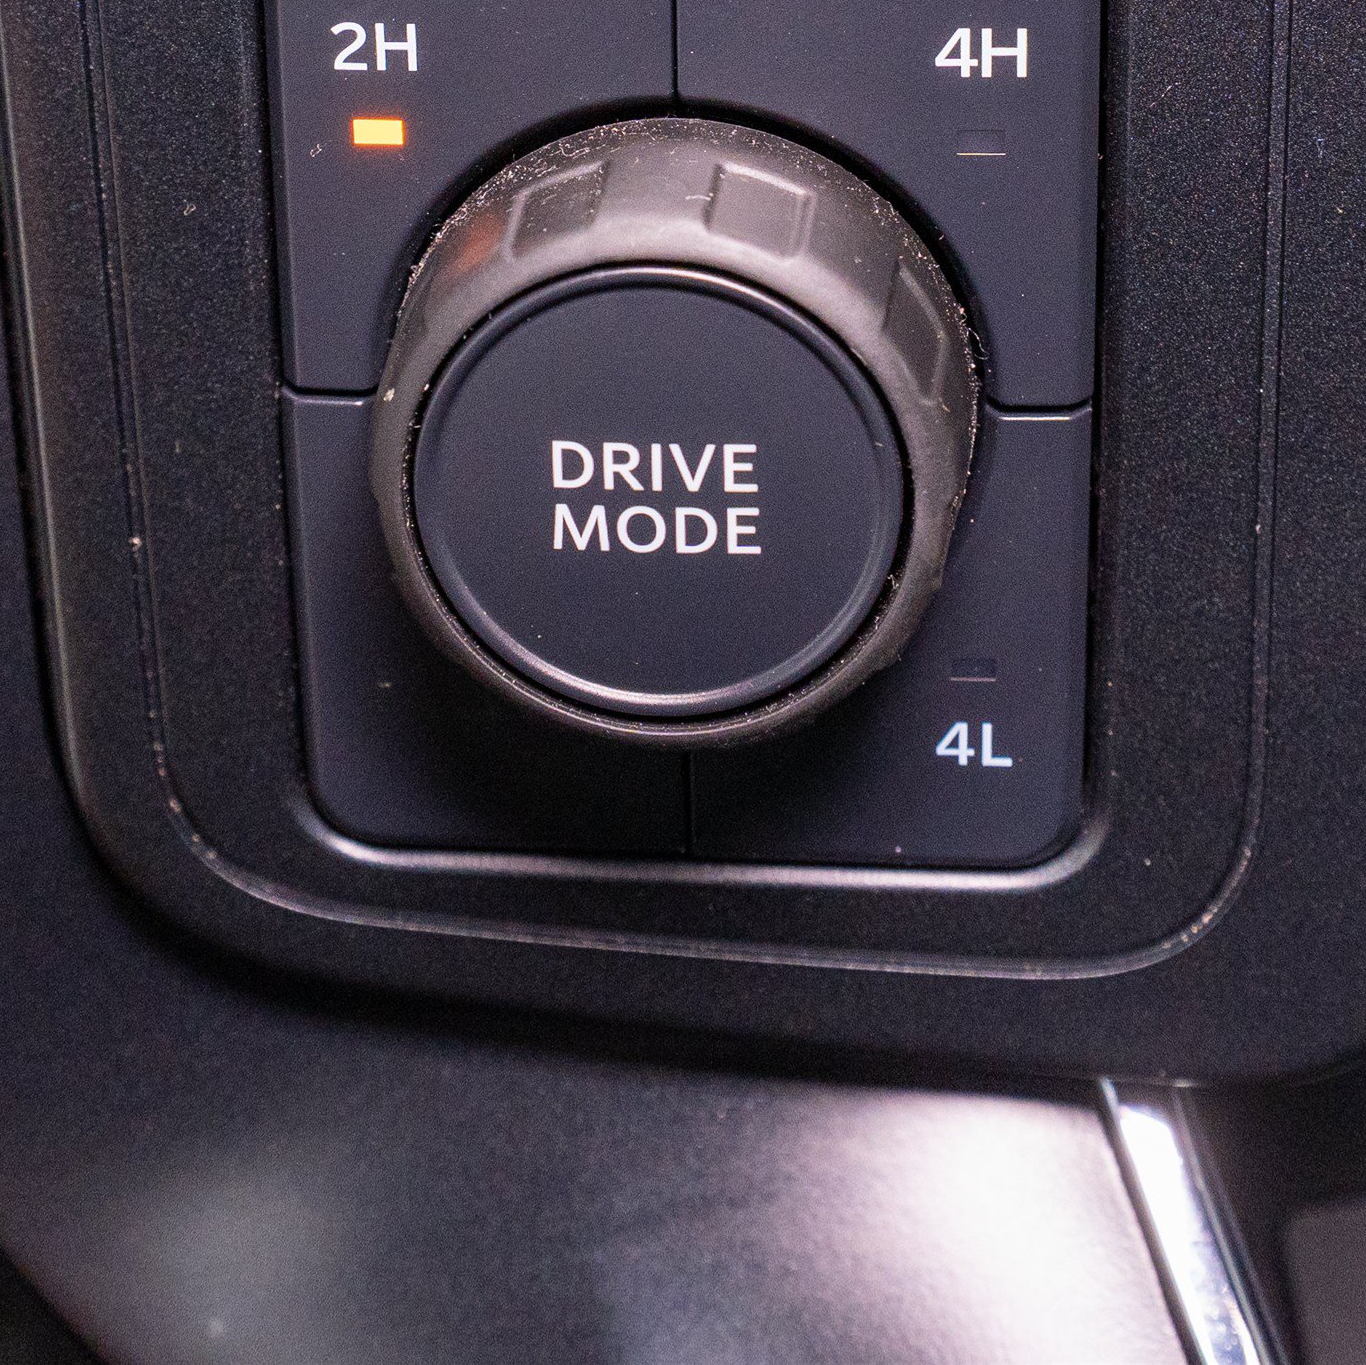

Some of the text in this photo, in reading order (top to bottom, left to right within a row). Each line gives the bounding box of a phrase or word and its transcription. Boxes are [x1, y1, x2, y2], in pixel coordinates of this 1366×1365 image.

[330, 21, 420, 74] 2H
[933, 27, 1030, 79] 4H
[550, 438, 760, 494] DRIVE
[551, 502, 763, 556] MODE
[935, 721, 1015, 768] 4L
